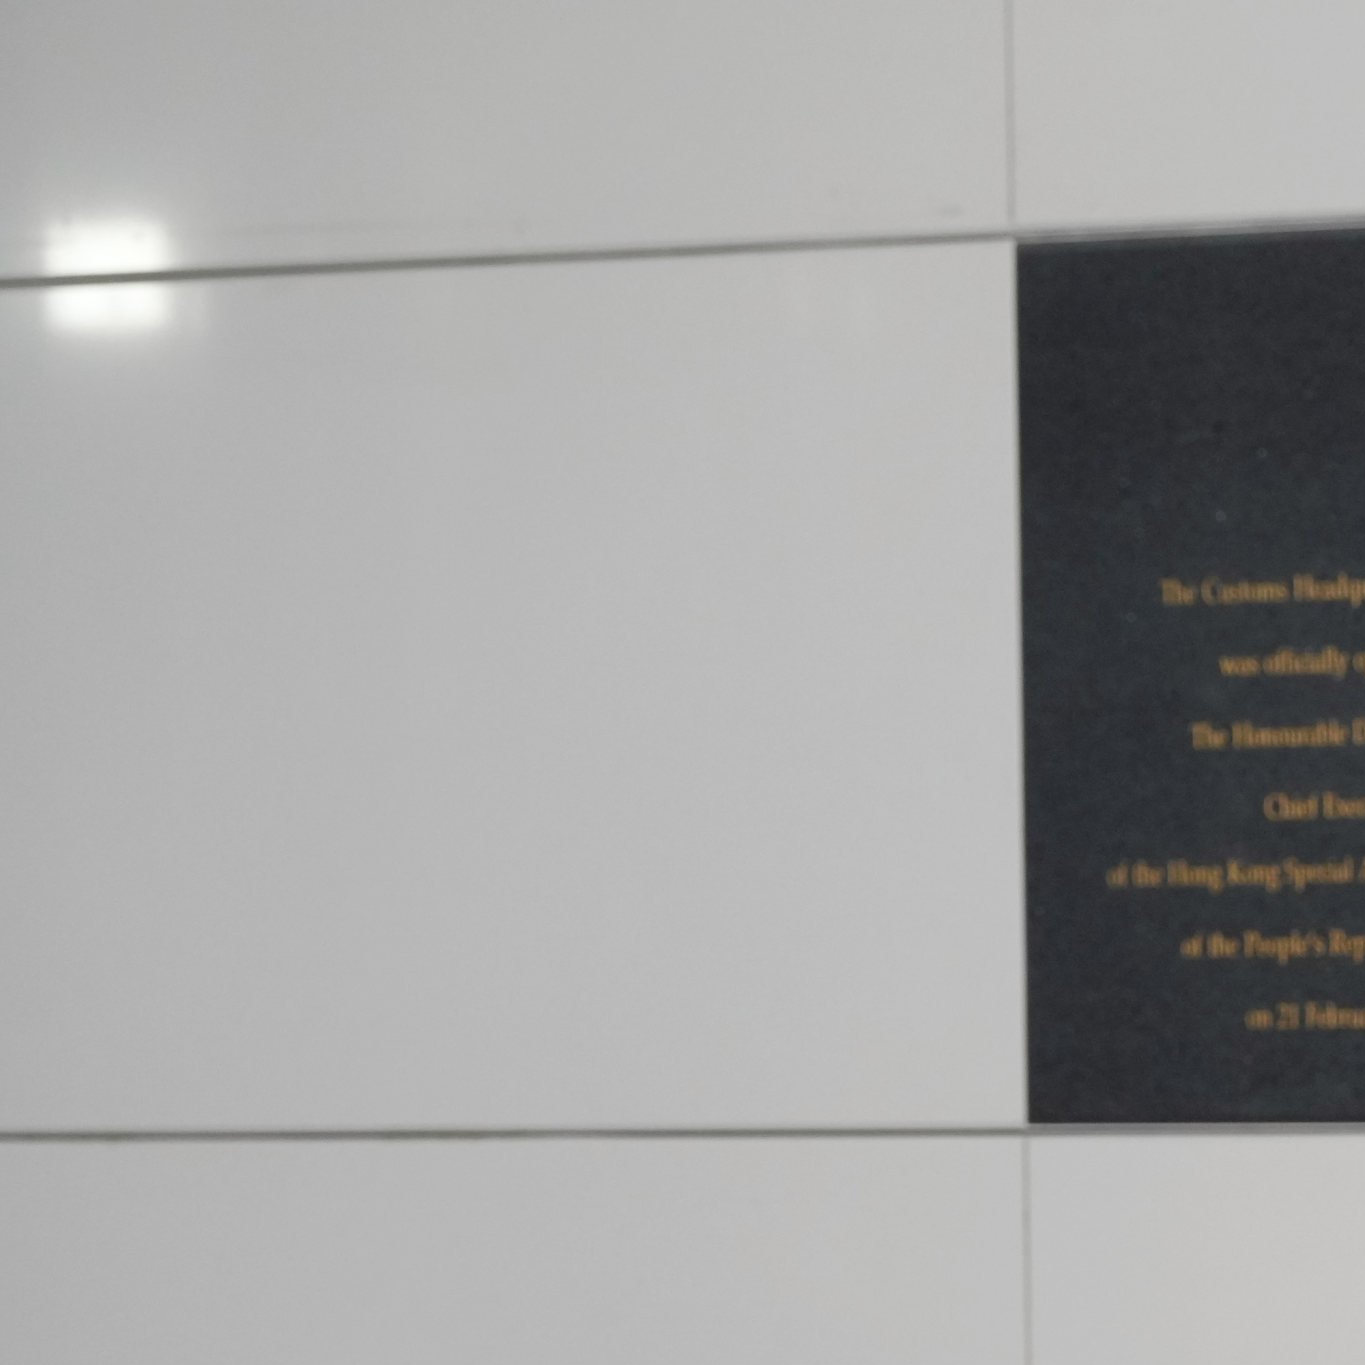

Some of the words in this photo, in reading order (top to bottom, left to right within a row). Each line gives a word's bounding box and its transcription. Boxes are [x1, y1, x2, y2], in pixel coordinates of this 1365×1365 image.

[1201, 577, 1288, 603] Customs
[1219, 654, 1261, 677] was
[1263, 645, 1350, 679] officially
[1232, 719, 1346, 749] Honourable
[1263, 793, 1318, 822] Chief
[1167, 859, 1223, 894] Hong
[1226, 859, 1280, 892] Kong
[1283, 857, 1354, 891] Special
